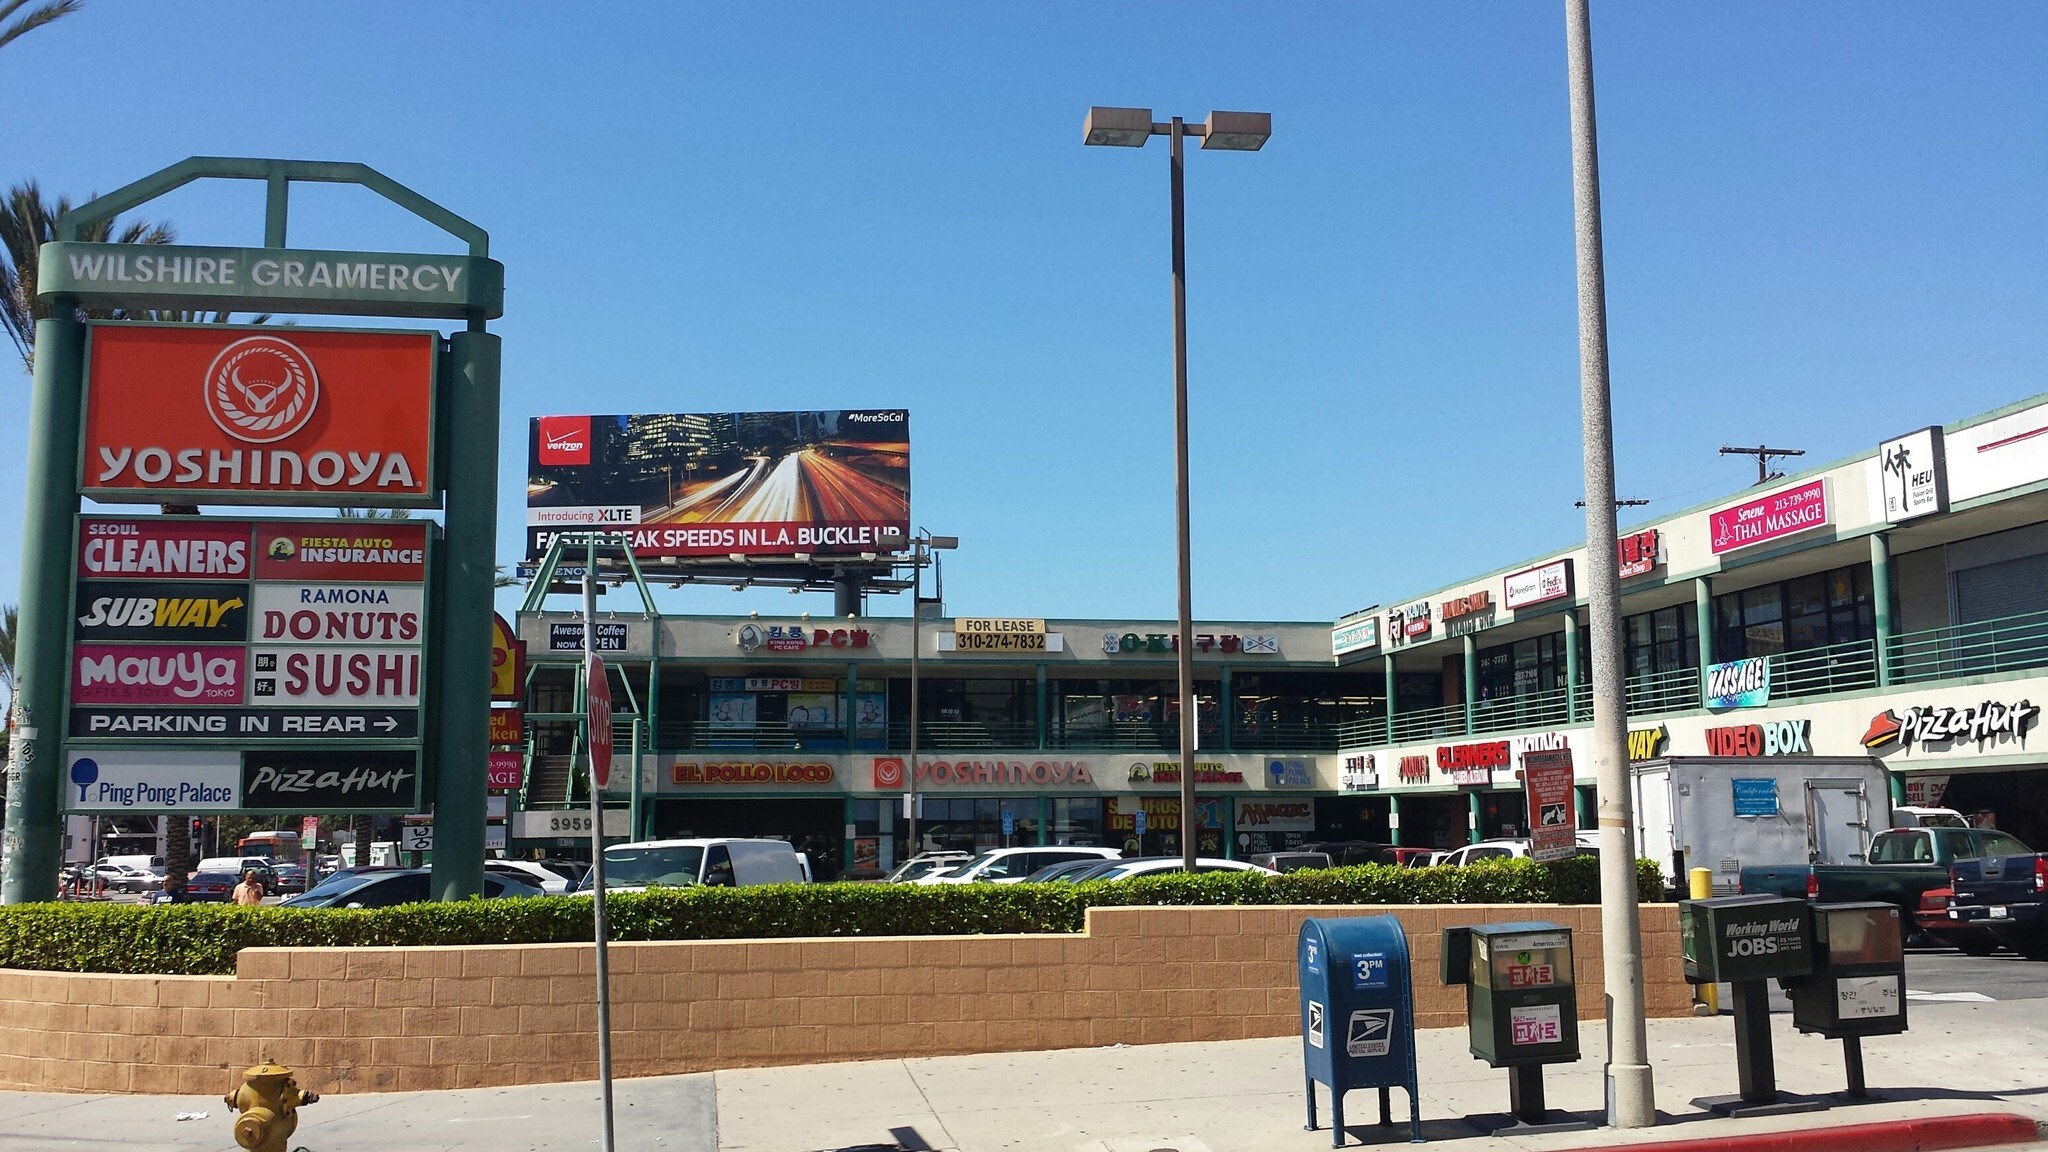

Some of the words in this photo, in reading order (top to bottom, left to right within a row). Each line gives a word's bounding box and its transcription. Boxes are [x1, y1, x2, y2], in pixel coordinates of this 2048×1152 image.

[69, 253, 236, 285] WILSHIRE
[251, 260, 463, 293] GRAMERCY
[848, 412, 904, 424] #MoreSoCal
[547, 441, 583, 451] verizon
[100, 446, 414, 487] YOSHINOYA
[1911, 469, 1933, 487] HEU
[1737, 505, 1765, 523] Serene
[1774, 488, 1821, 511] 213-739-9990
[538, 510, 594, 523] Introducing
[598, 509, 632, 522] XLTE
[1733, 520, 1763, 542] THAI
[1766, 503, 1822, 534] MASSAGE
[88, 524, 140, 535] SEOUL
[663, 529, 734, 548] SPEEDS
[738, 529, 757, 546] IN
[760, 528, 795, 546] L.A.
[797, 527, 871, 545] BUCKLE
[301, 538, 349, 548] FIESTA
[353, 538, 393, 549] AUTO
[84, 538, 246, 574] CLEANERS
[301, 549, 423, 564] INSURANCE
[301, 588, 390, 605] RAMONA
[78, 597, 245, 628] SUBWAY
[262, 609, 418, 641] DONUTS
[552, 625, 584, 636] Aweso
[597, 624, 626, 636] Coffee
[966, 620, 989, 632] FOR
[992, 620, 1035, 633] LEASE
[556, 641, 577, 649] NOW
[958, 633, 1045, 650] 310-274-7832
[284, 653, 419, 696] SUSHI
[205, 688, 235, 698] TOKYO
[90, 715, 227, 732] PARKING
[239, 716, 270, 732] IN
[282, 716, 366, 732] REAR
[590, 695, 611, 746] STOP
[1704, 723, 1762, 757] VIDEO
[1764, 719, 1808, 756] BOX
[1436, 741, 1509, 769] CLEANERS
[673, 762, 701, 784] EL
[704, 762, 773, 784] POLLO
[774, 762, 833, 784] LOCO
[915, 760, 1092, 785] YOSHINOYA
[99, 782, 135, 806] Ping
[136, 782, 178, 806] Pong
[179, 782, 232, 803] Palace
[1906, 792, 1925, 801] SELL
[1907, 783, 1926, 792] BUY
[1112, 815, 1134, 830] DE
[1725, 921, 1768, 937] Working
[1768, 918, 1800, 933] World
[1727, 936, 1778, 958] JOBS
